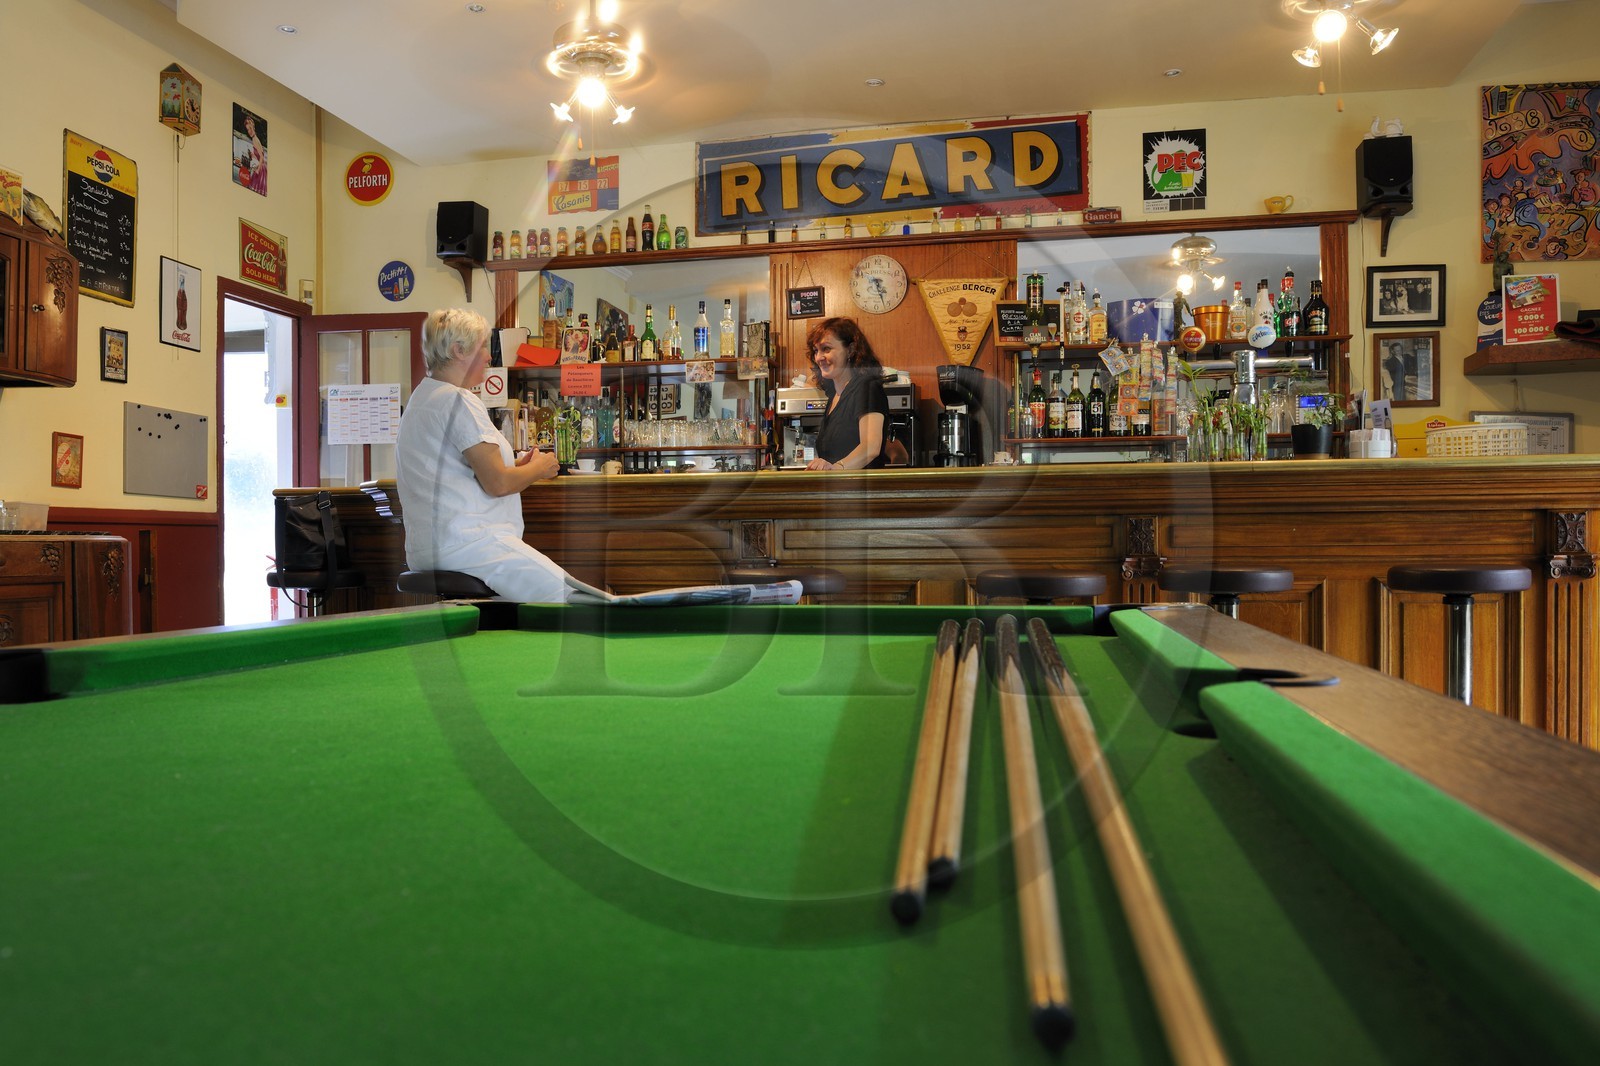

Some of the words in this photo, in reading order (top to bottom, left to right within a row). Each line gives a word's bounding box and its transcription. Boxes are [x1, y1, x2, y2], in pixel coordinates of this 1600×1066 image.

[1157, 151, 1202, 173] PEC
[349, 174, 388, 188] PELFORTH
[721, 130, 1060, 217] RICARD
[578, 181, 588, 190] 15
[597, 179, 608, 189] 22
[554, 194, 590, 211] Casanis
[1085, 211, 1119, 221] Gancia
[248, 231, 258, 242] ICE
[260, 237, 275, 251] COLD
[246, 267, 261, 278] SOLD
[263, 273, 277, 284] HERE
[928, 285, 960, 298] CHALLENGE
[962, 284, 997, 295] BERGER
[955, 343, 972, 352] 1952
